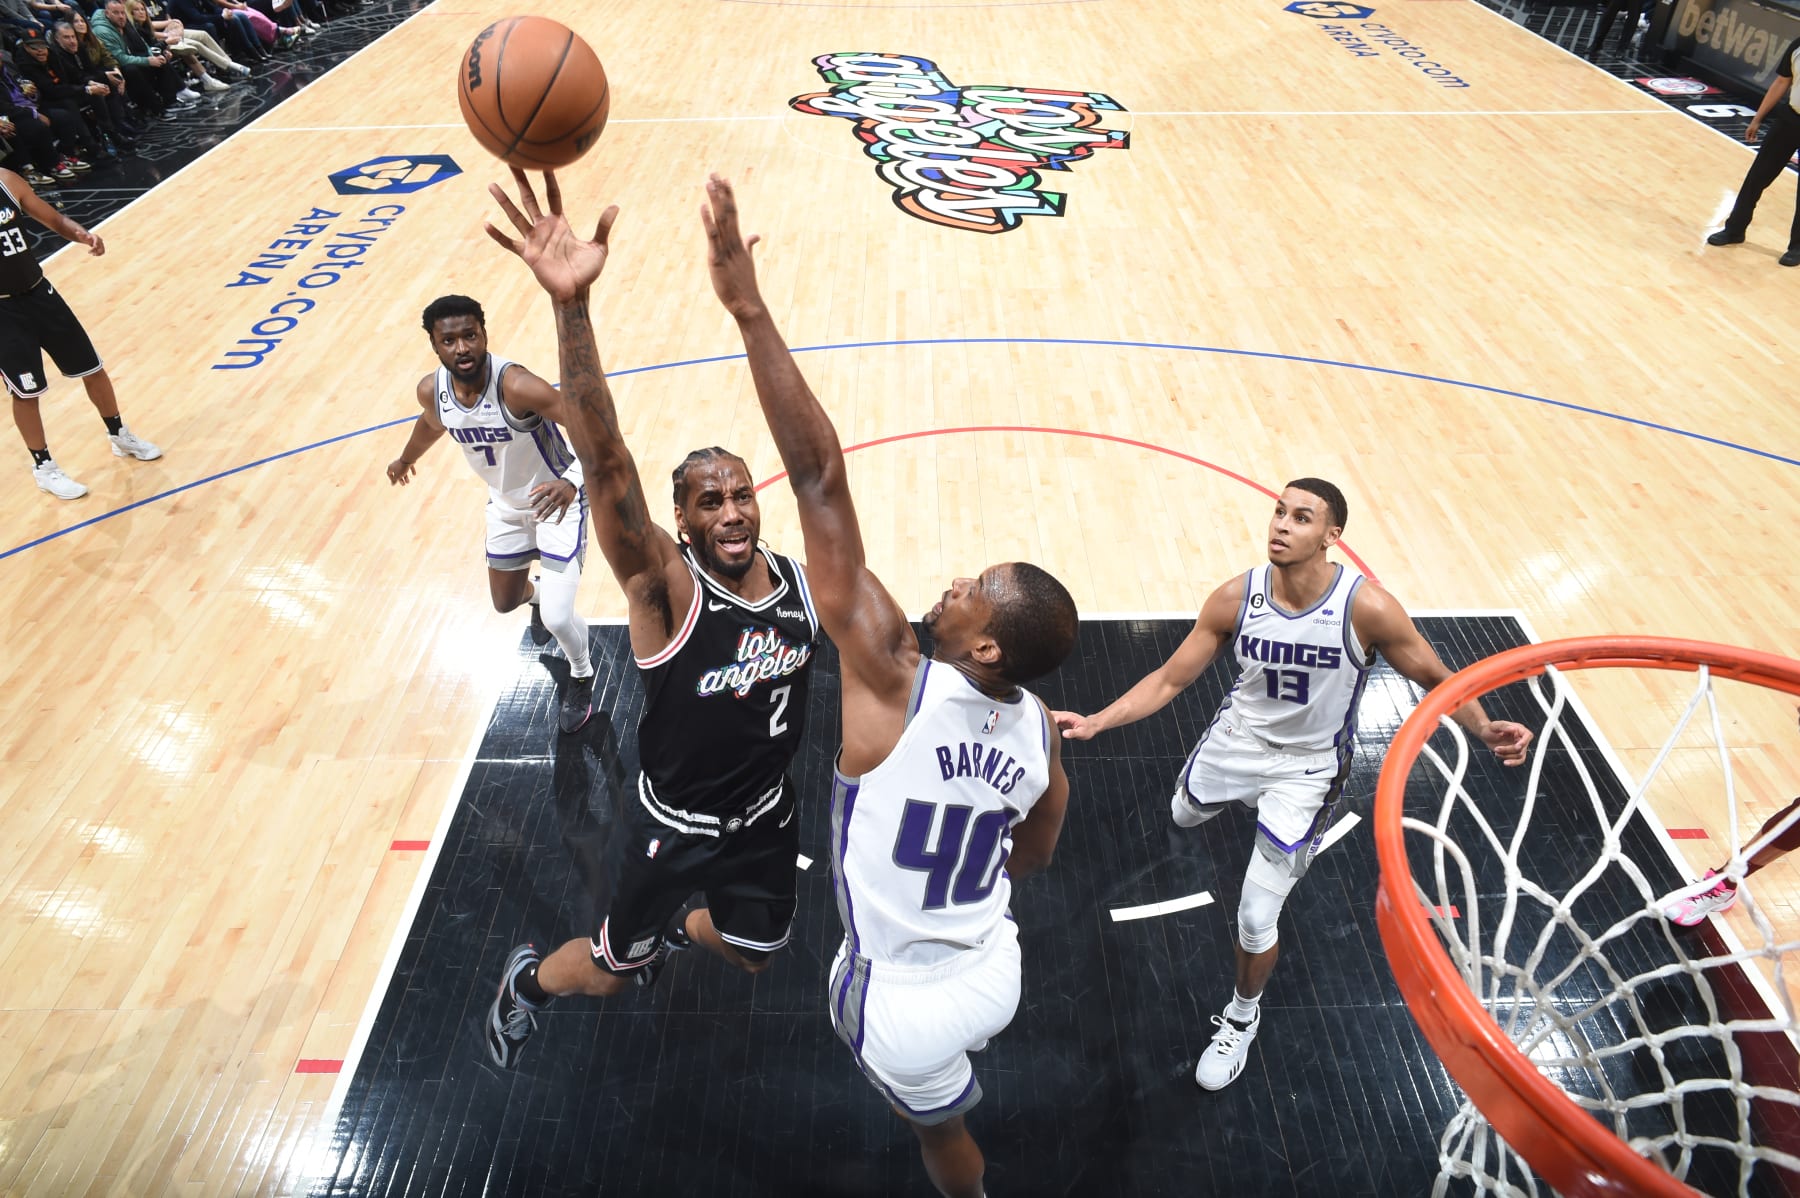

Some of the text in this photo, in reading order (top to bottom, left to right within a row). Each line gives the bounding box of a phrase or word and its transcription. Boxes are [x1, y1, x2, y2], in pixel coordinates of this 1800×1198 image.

[1317, 24, 1380, 57] ARENA
[1360, 23, 1470, 88] crypto.com
[1678, 0, 1791, 83] betway
[0, 227, 28, 256] 33
[224, 207, 342, 287] ARENA
[211, 204, 405, 369] crypto.com
[472, 445, 496, 466] 7
[1251, 593, 1264, 609] 6
[1313, 618, 1341, 627] dialpad
[737, 629, 783, 663] los
[1241, 635, 1342, 669] KINGS
[699, 644, 811, 697] angeles
[1263, 668, 1309, 705] 13
[769, 685, 791, 737] 2
[936, 742, 1026, 795] BARNES
[892, 798, 1020, 910] 40
